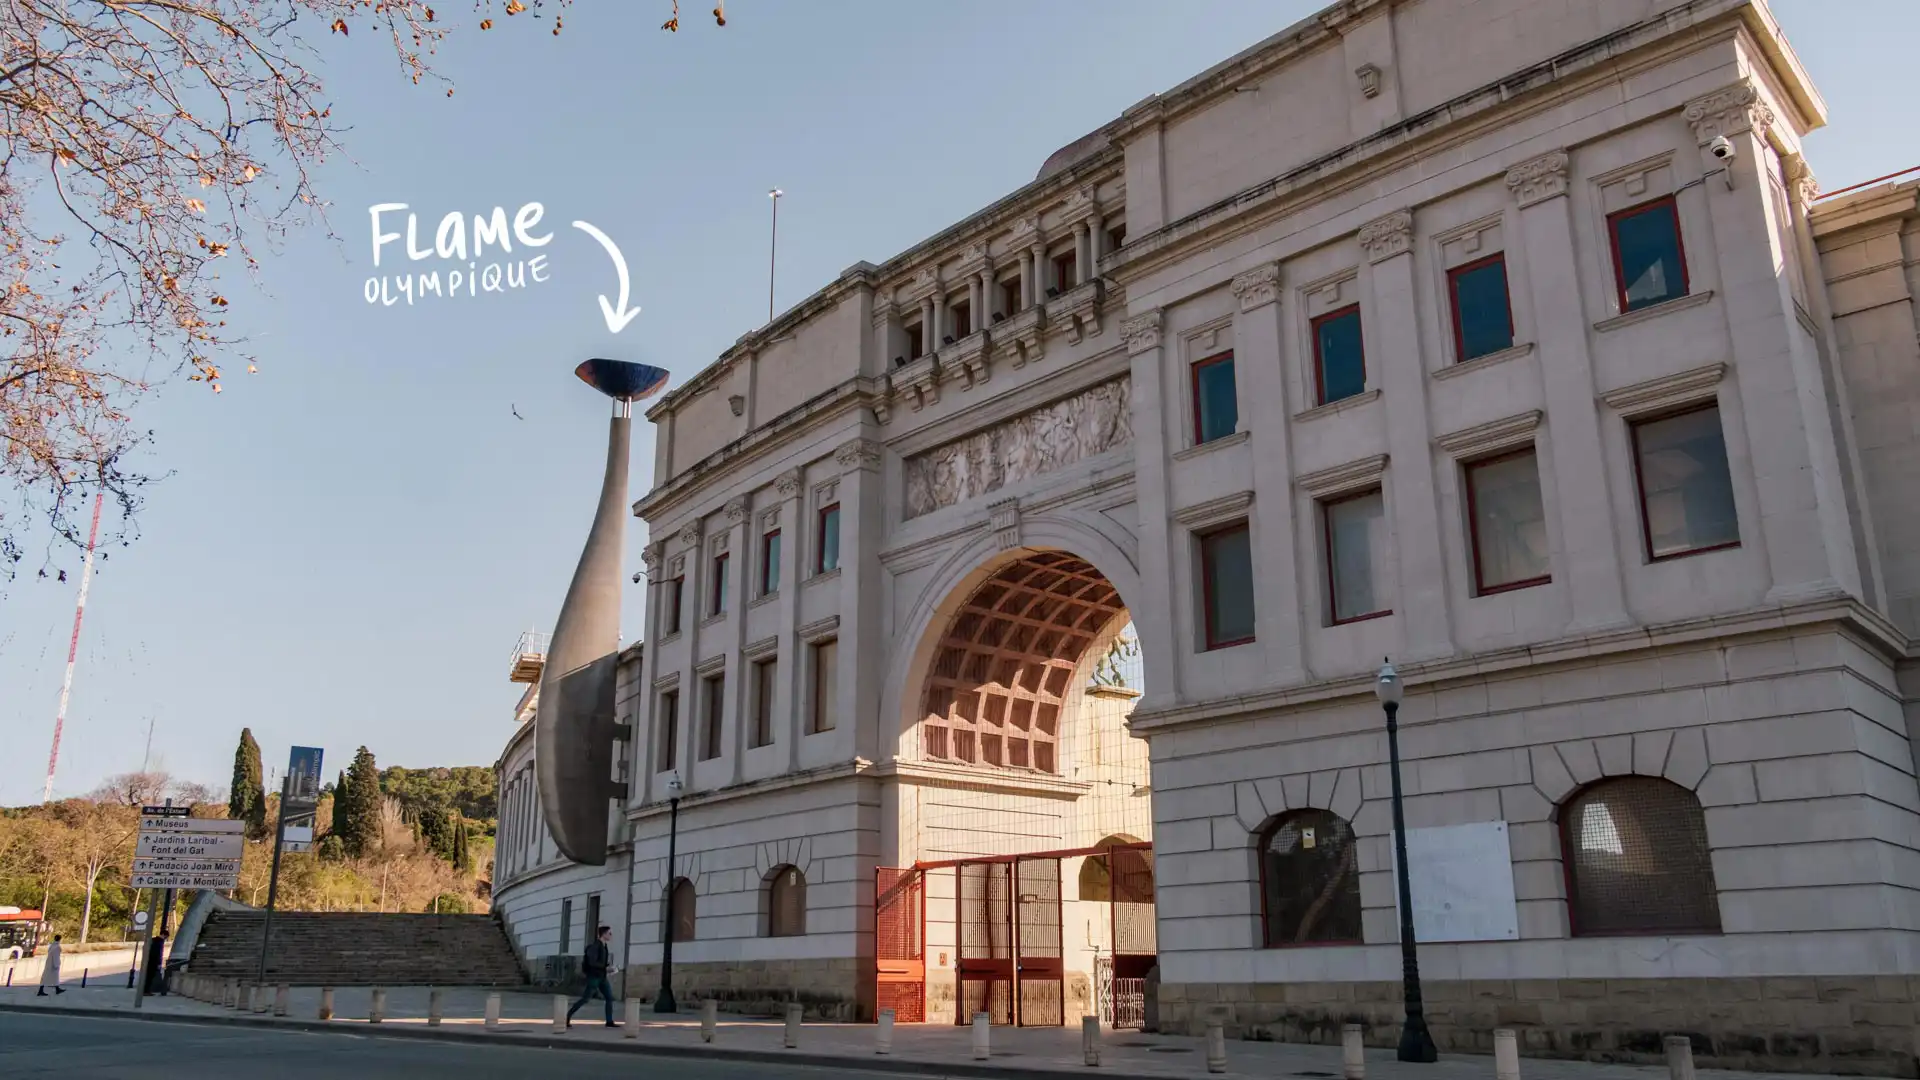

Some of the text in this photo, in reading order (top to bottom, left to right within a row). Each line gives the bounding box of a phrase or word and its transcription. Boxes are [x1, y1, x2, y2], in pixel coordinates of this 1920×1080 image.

[155, 819, 189, 828] Museus
[152, 835, 186, 844] Jardins
[188, 836, 218, 845] Laribal
[151, 845, 205, 855] Font del Gat
[148, 861, 234, 871] Fundació Joan Miró
[146, 877, 231, 887] Castell de Montjuïc
